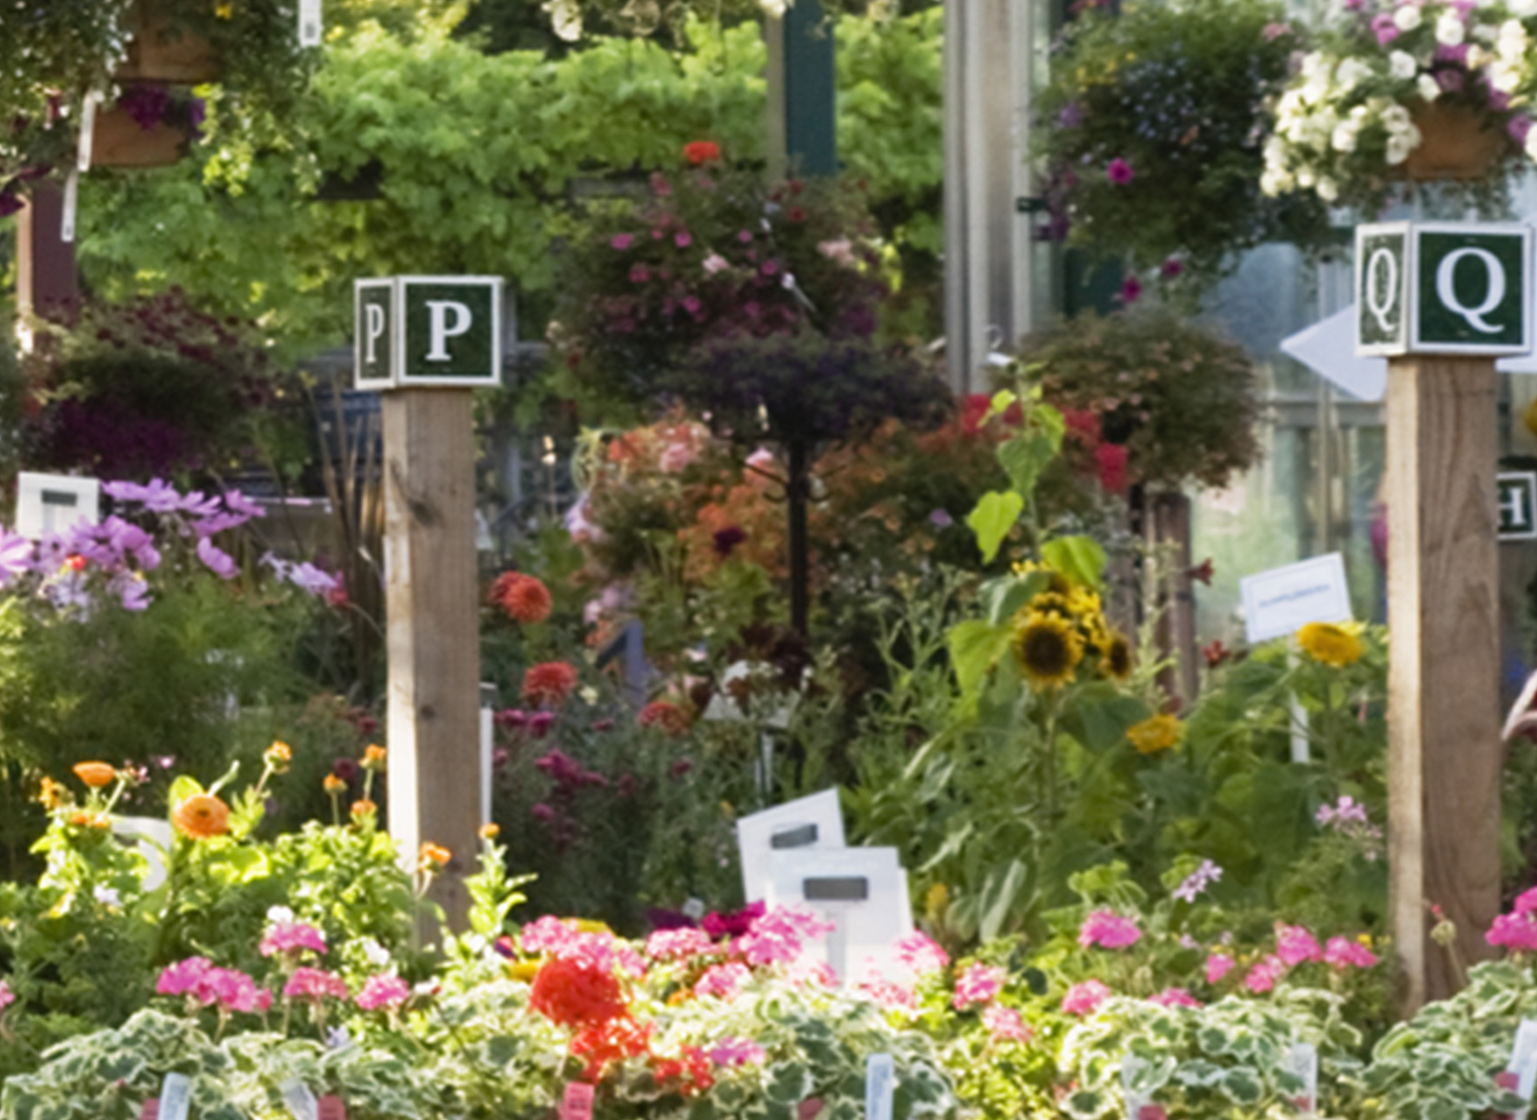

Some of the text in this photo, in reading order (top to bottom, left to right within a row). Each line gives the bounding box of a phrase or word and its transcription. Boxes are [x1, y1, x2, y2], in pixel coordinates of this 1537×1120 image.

[1367, 247, 1398, 332] Q
[1436, 247, 1507, 334] Q
[365, 303, 385, 364] P
[424, 300, 472, 362] P
